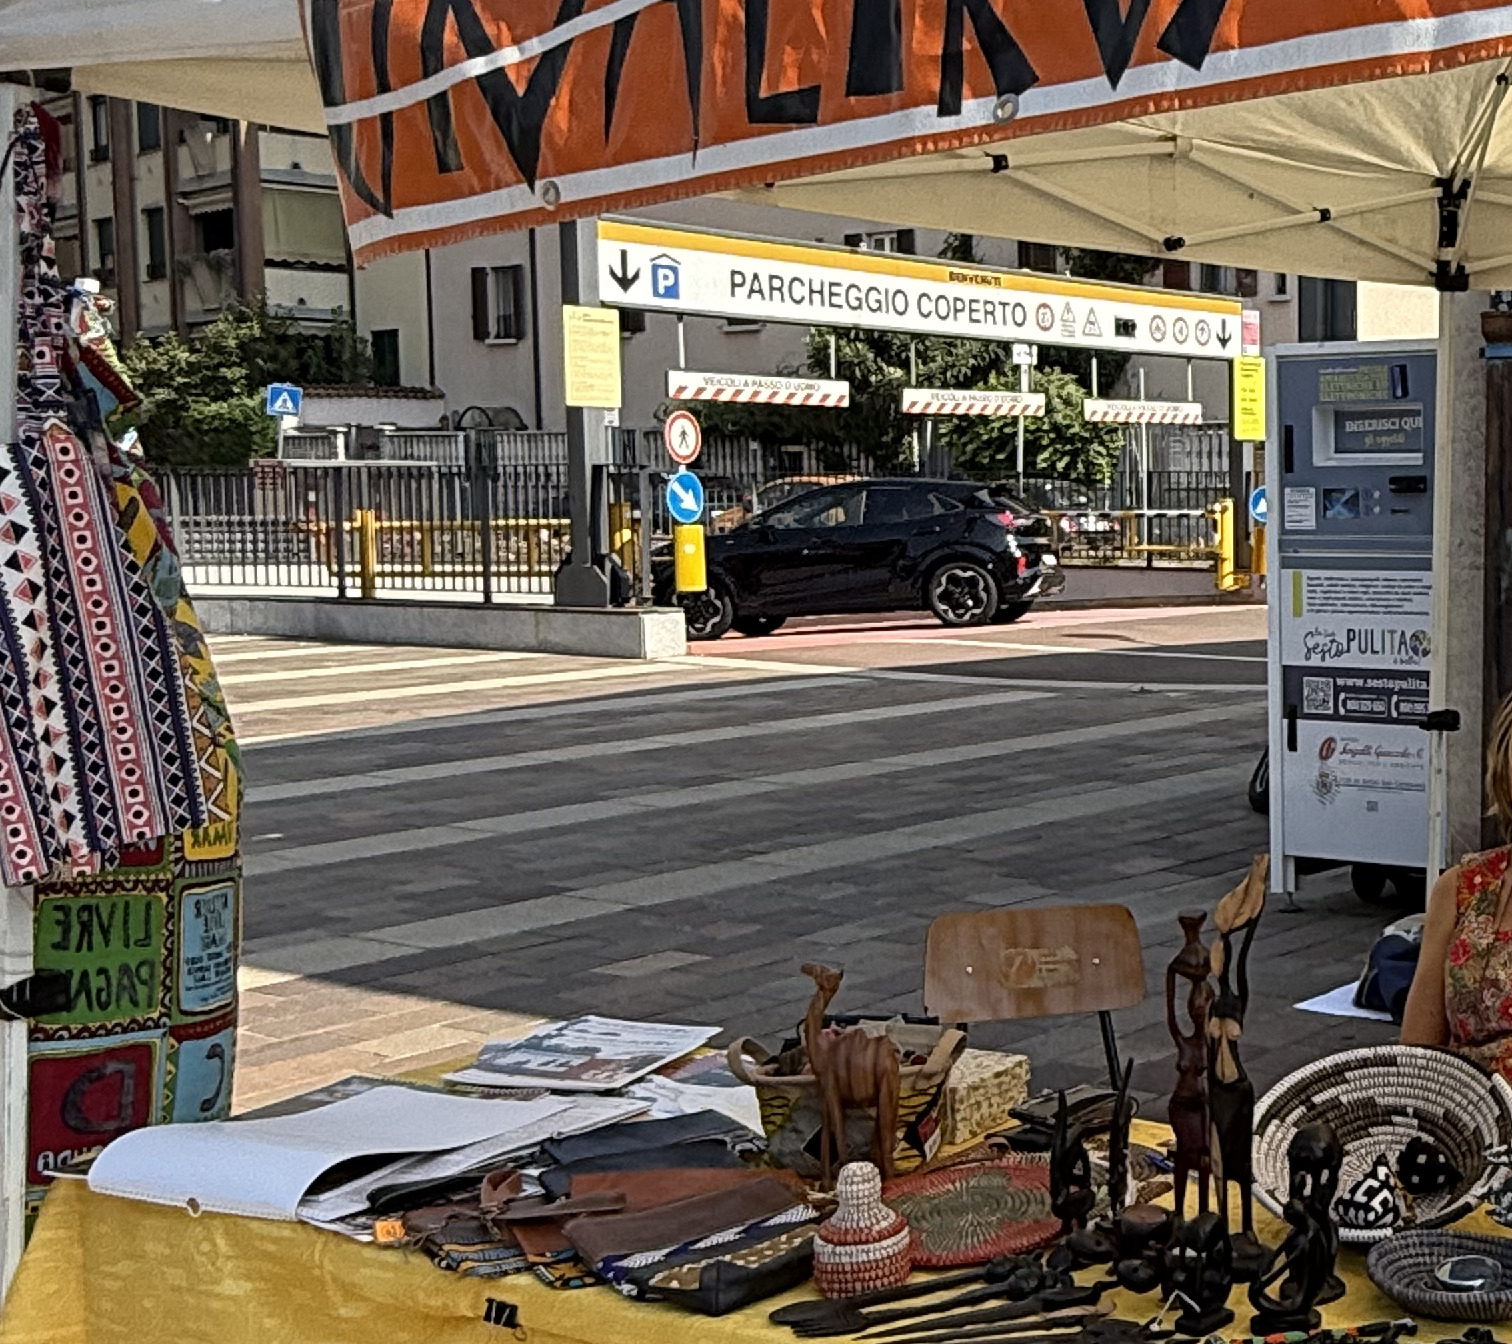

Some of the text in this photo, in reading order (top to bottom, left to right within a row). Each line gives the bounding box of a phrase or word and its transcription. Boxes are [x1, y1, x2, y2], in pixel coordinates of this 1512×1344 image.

[730, 269, 1027, 327] PARCHEGGIO COPERTO
[1347, 628, 1410, 656] PULITA
